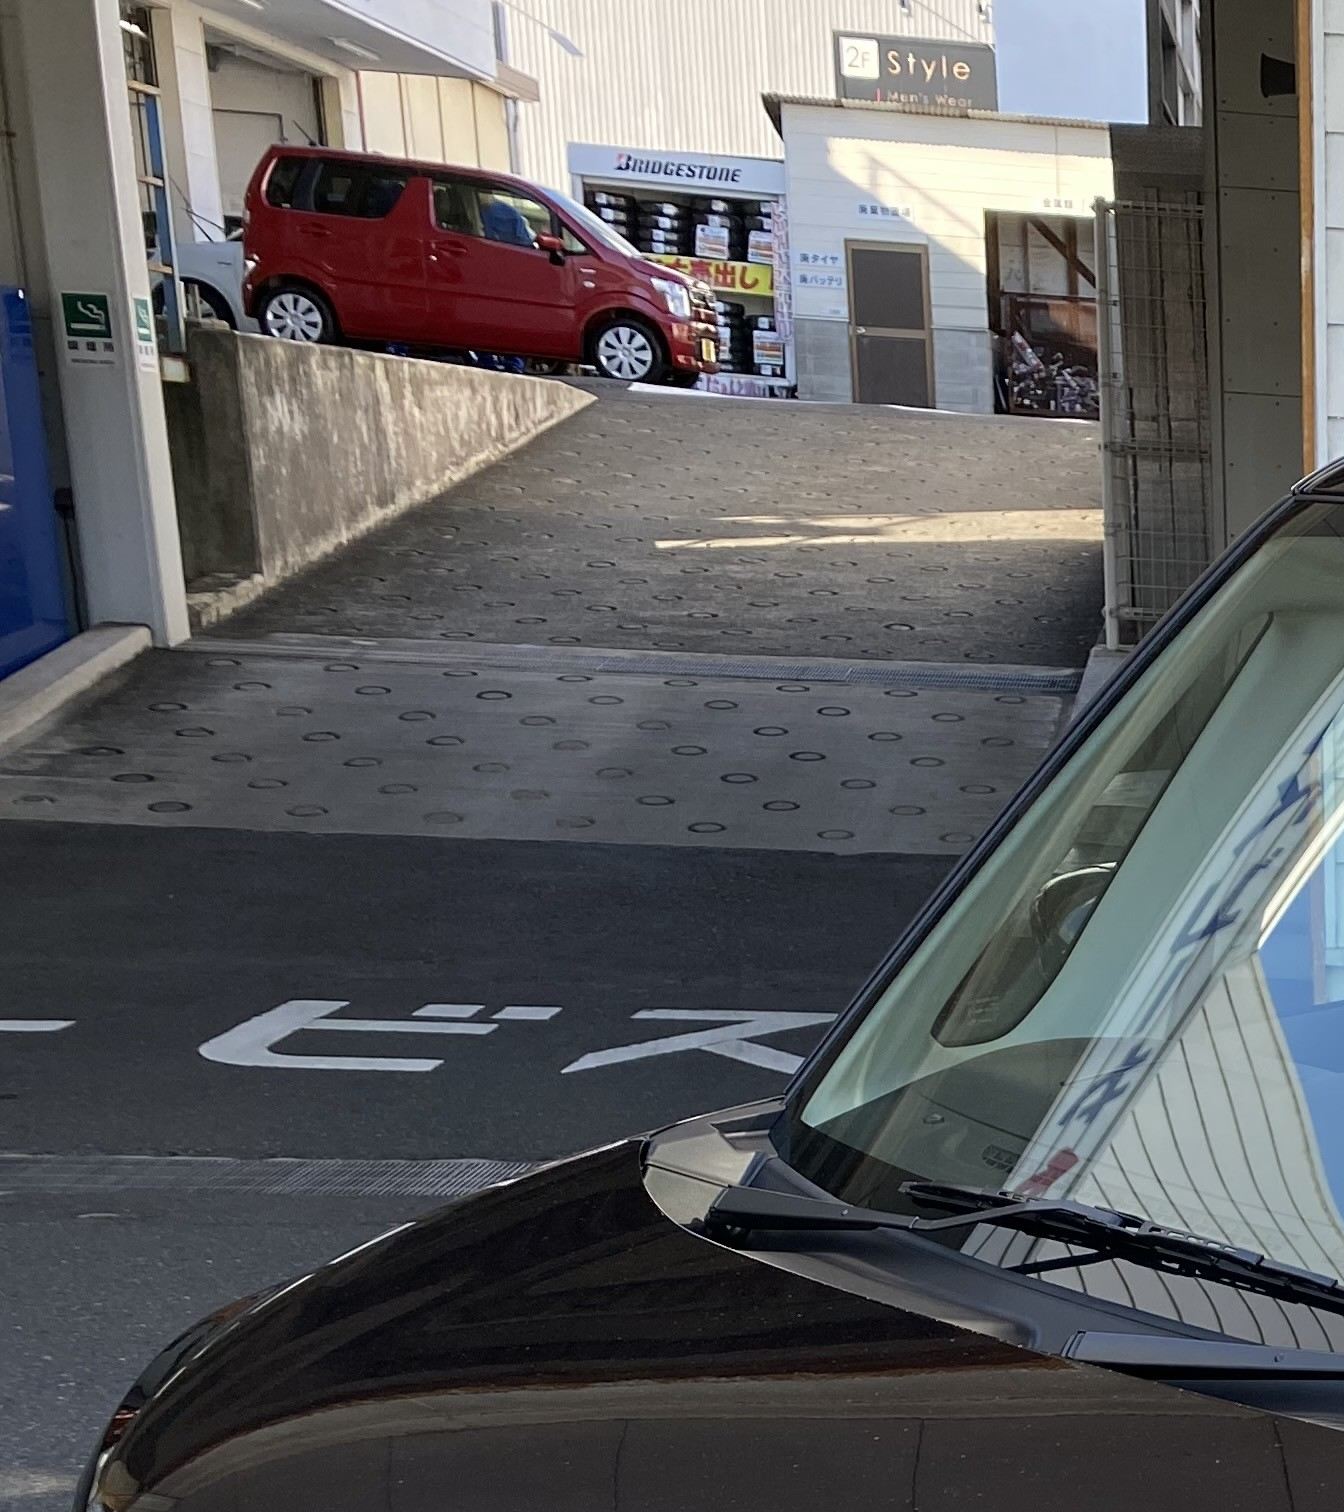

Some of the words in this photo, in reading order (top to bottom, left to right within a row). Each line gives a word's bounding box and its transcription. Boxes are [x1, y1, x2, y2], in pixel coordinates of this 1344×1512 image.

[846, 46, 870, 69] 2F
[887, 50, 970, 82] Style
[935, 93, 972, 108] Wear
[615, 153, 742, 183] BRIDGESTONE
